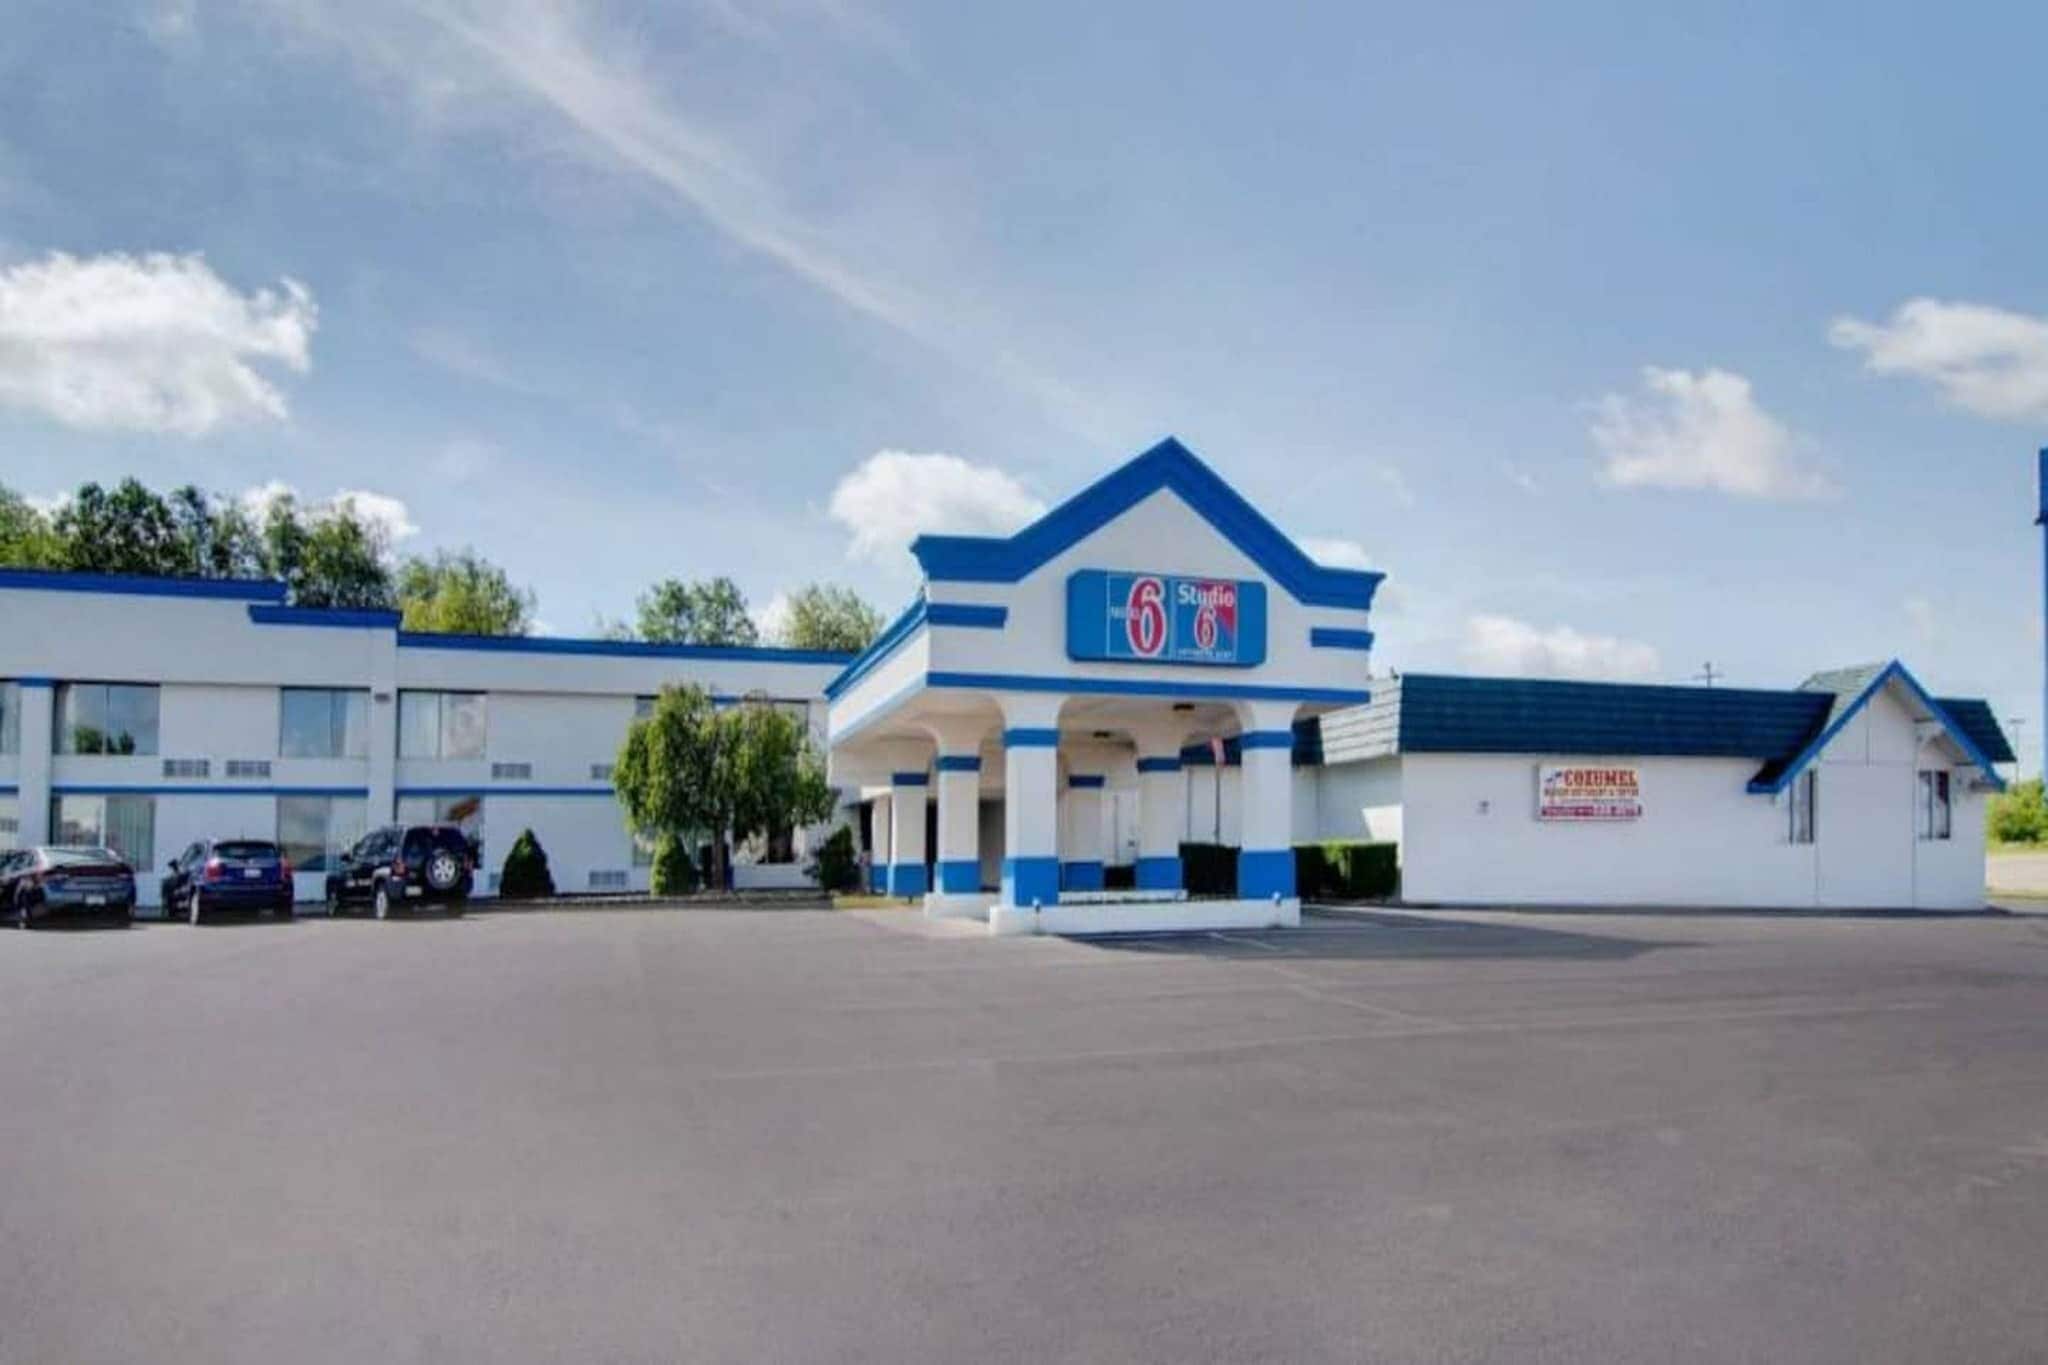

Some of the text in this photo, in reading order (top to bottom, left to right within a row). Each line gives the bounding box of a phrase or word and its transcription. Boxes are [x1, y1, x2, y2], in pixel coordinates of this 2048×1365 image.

[1127, 577, 1166, 658] 6
[1178, 584, 1234, 607] Studio
[1194, 605, 1217, 649] 6
